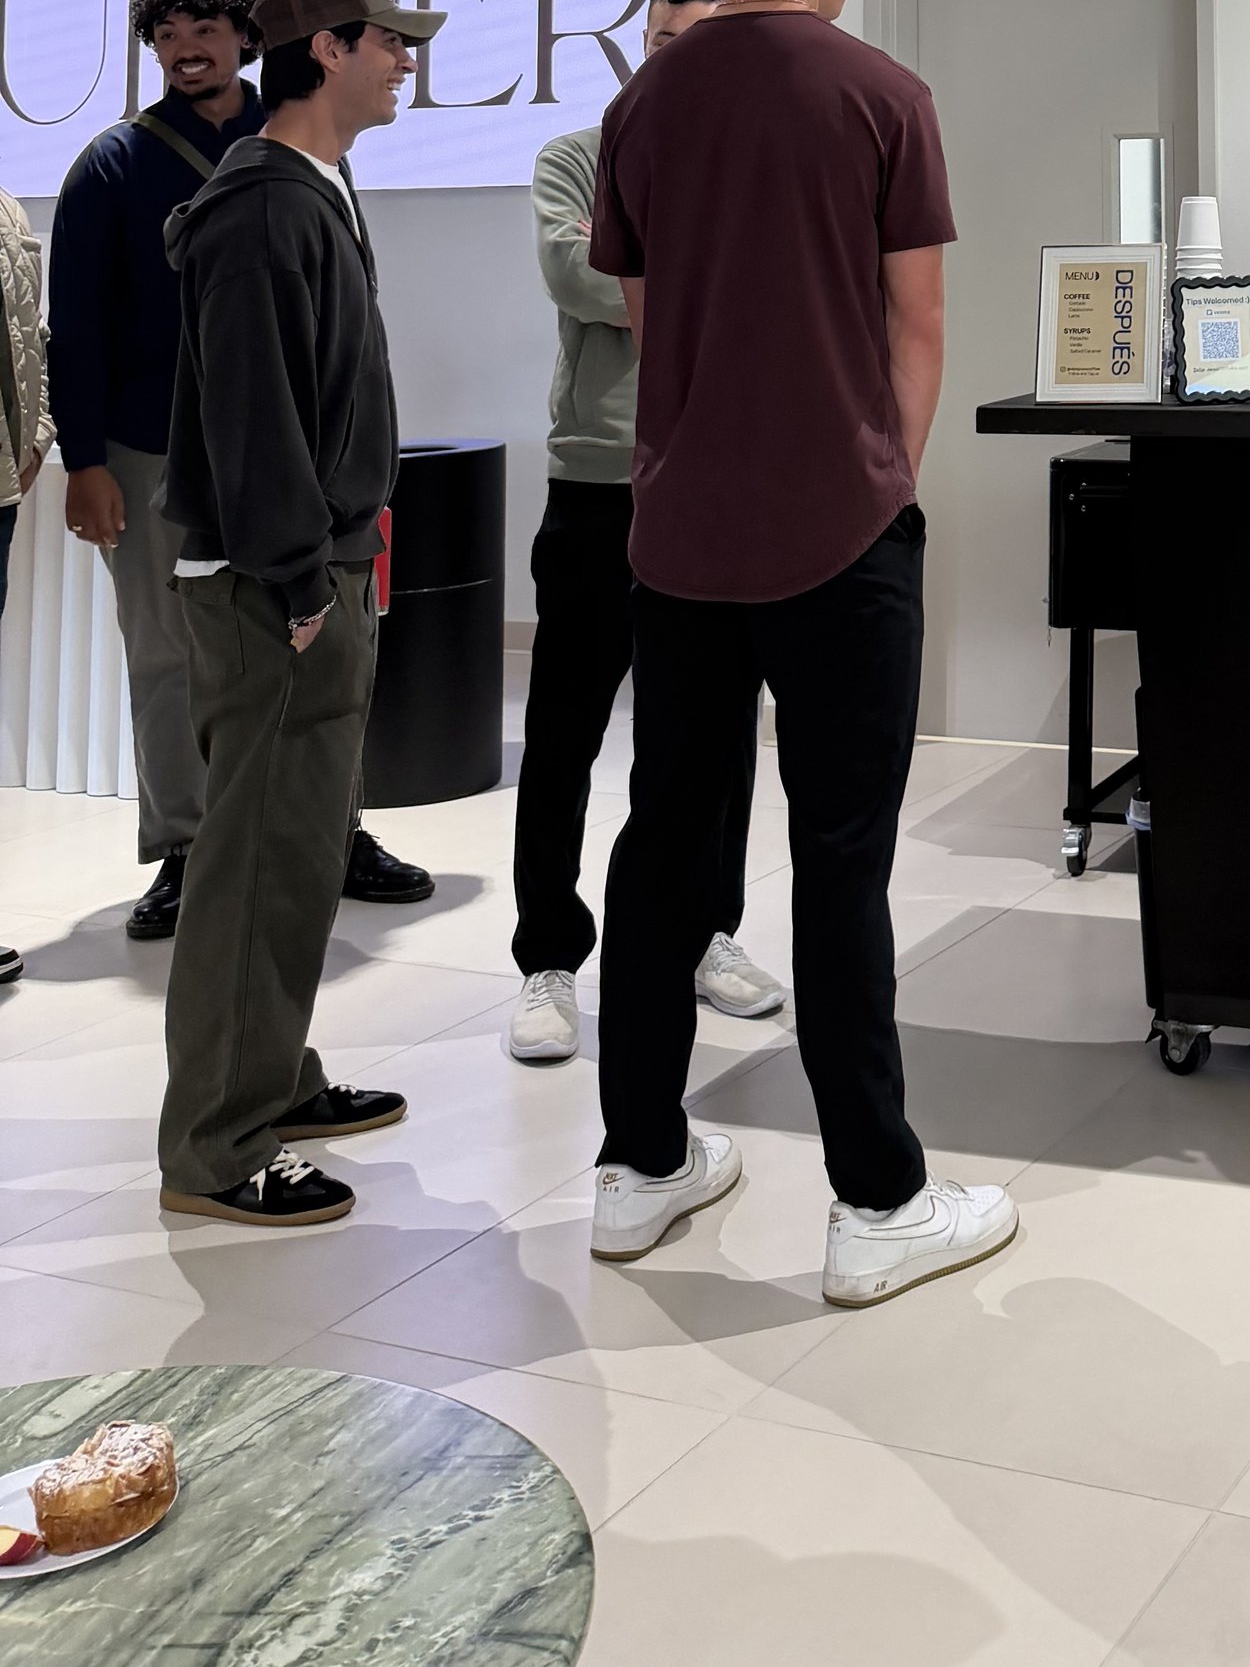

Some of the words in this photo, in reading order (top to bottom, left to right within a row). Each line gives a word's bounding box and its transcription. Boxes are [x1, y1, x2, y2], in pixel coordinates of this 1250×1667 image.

[1065, 271, 1094, 281] MENU
[1186, 298, 1202, 306] Tips
[1203, 296, 1244, 305] Welcomed
[1111, 269, 1135, 376] DESPUÉS
[602, 1185, 620, 1193] AIR
[873, 1279, 888, 1294] AIR
